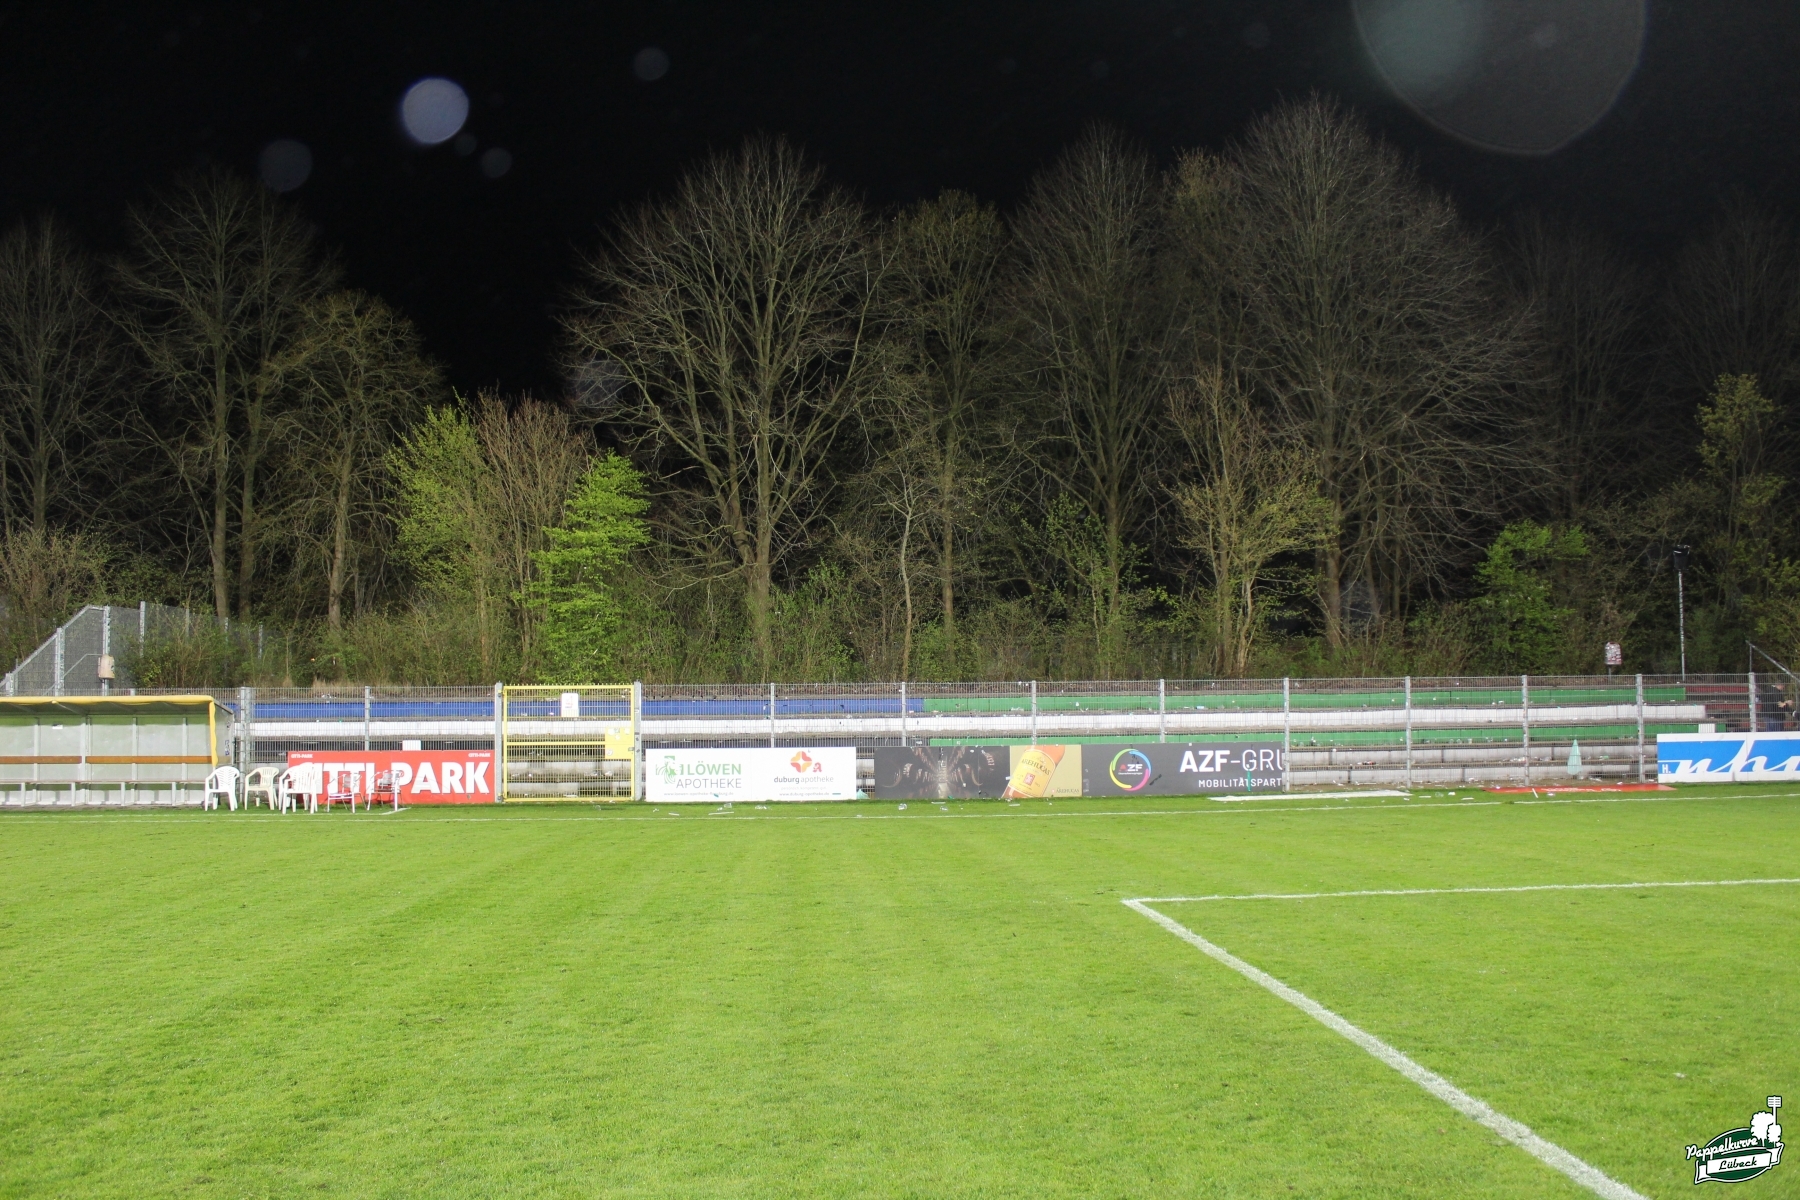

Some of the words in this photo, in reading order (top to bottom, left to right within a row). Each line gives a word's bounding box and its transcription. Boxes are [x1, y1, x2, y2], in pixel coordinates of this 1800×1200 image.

[687, 760, 742, 776] LÖWEN
[1119, 763, 1143, 772] AZF
[1661, 764, 1671, 774] H.
[676, 778, 742, 789] APOTHEKE
[773, 776, 800, 784] duburg
[800, 775, 834, 784] apotheke
